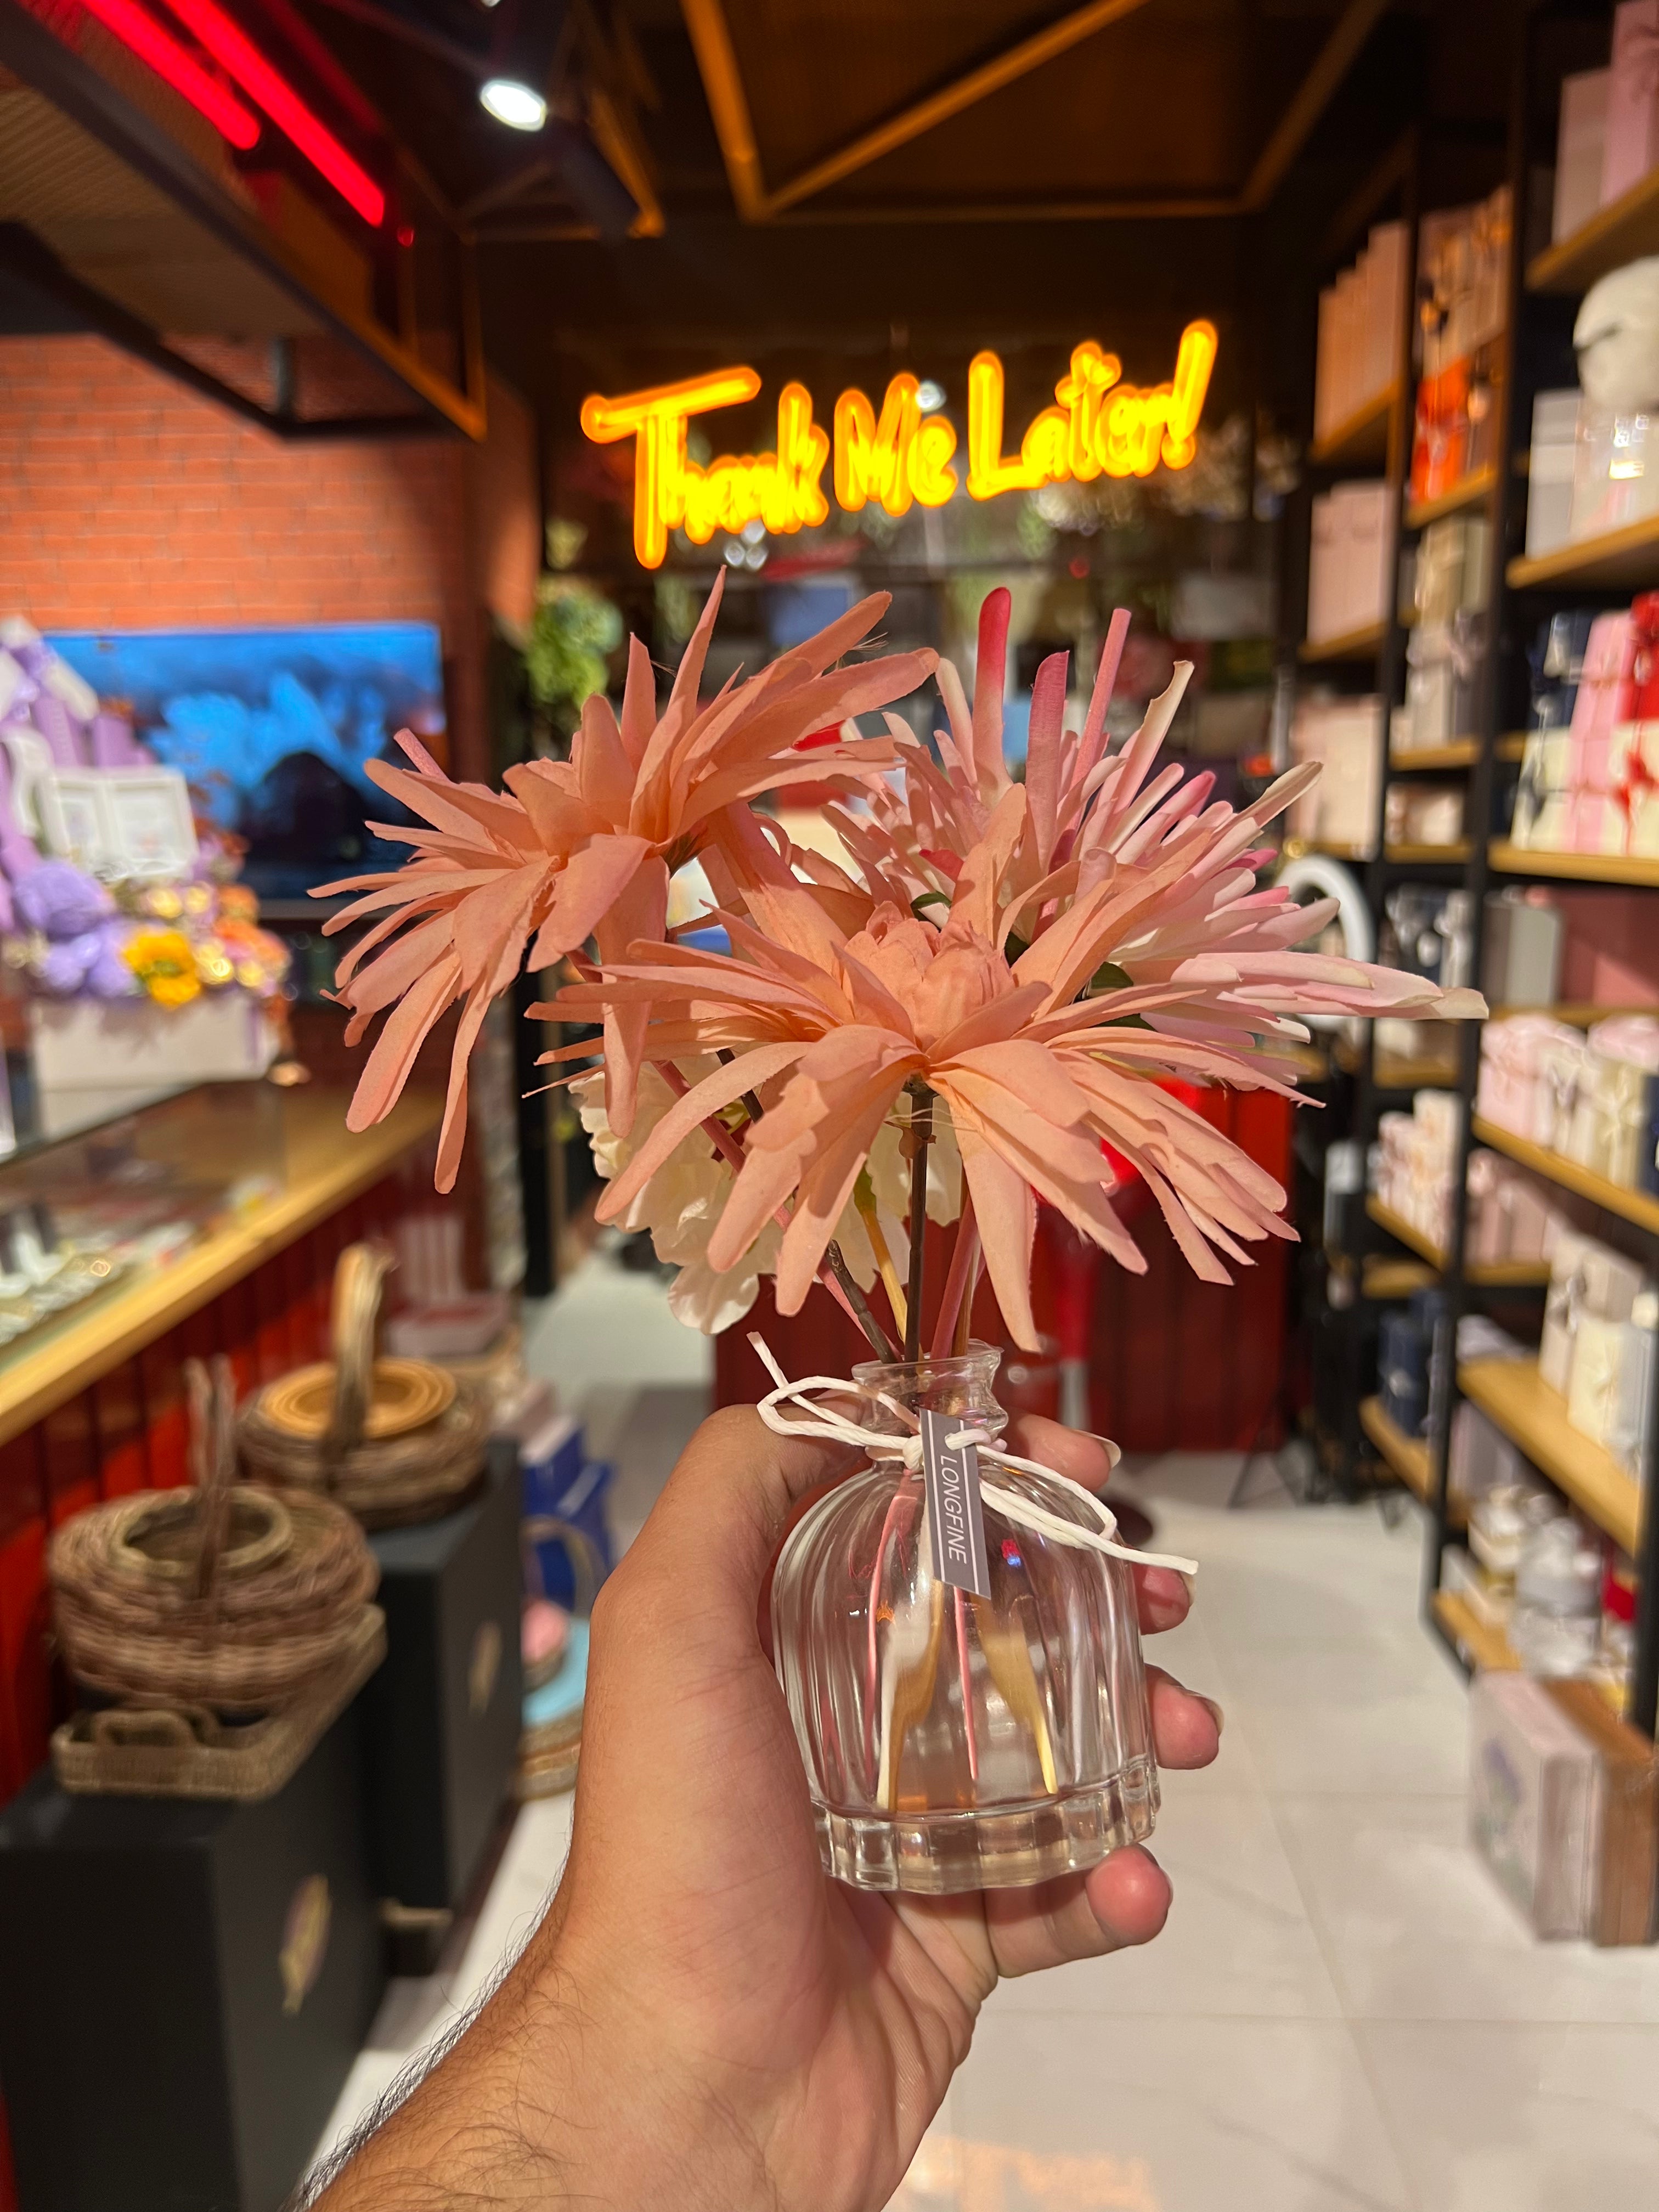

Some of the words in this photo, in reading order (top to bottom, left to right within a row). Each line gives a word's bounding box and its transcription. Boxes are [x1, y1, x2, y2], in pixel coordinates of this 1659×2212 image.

[580, 368, 830, 569] Thank
[834, 374, 958, 517] Me
[966, 321, 1217, 501] Later!
[940, 1454, 967, 1565] LONGFINE
